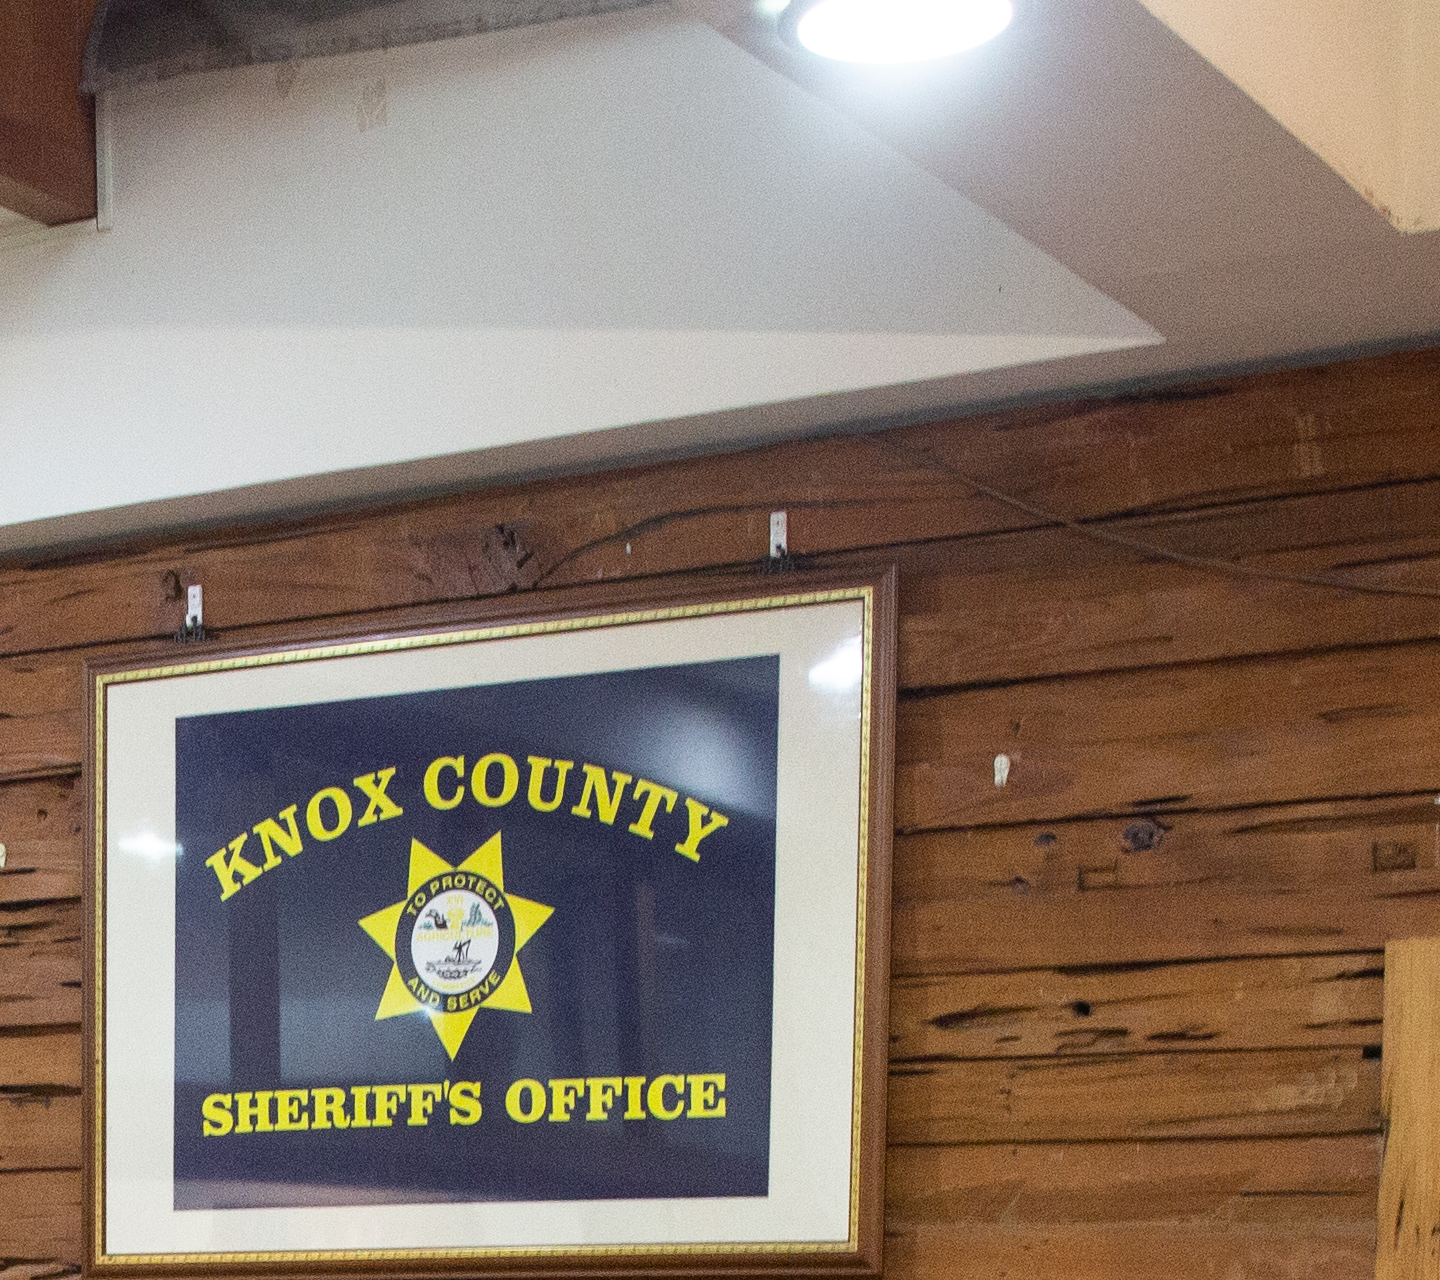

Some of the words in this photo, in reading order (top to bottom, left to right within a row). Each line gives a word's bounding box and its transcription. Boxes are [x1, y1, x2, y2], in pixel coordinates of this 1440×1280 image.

[206, 767, 404, 902] KNOX
[423, 752, 728, 863] COUNTY
[406, 892, 427, 917] TO
[429, 875, 505, 911] PROTECT
[407, 976, 441, 1006] AND
[446, 969, 502, 1011] SERVE
[201, 1078, 483, 1136] SHERIFF'S
[504, 1073, 727, 1124] OFFICE
